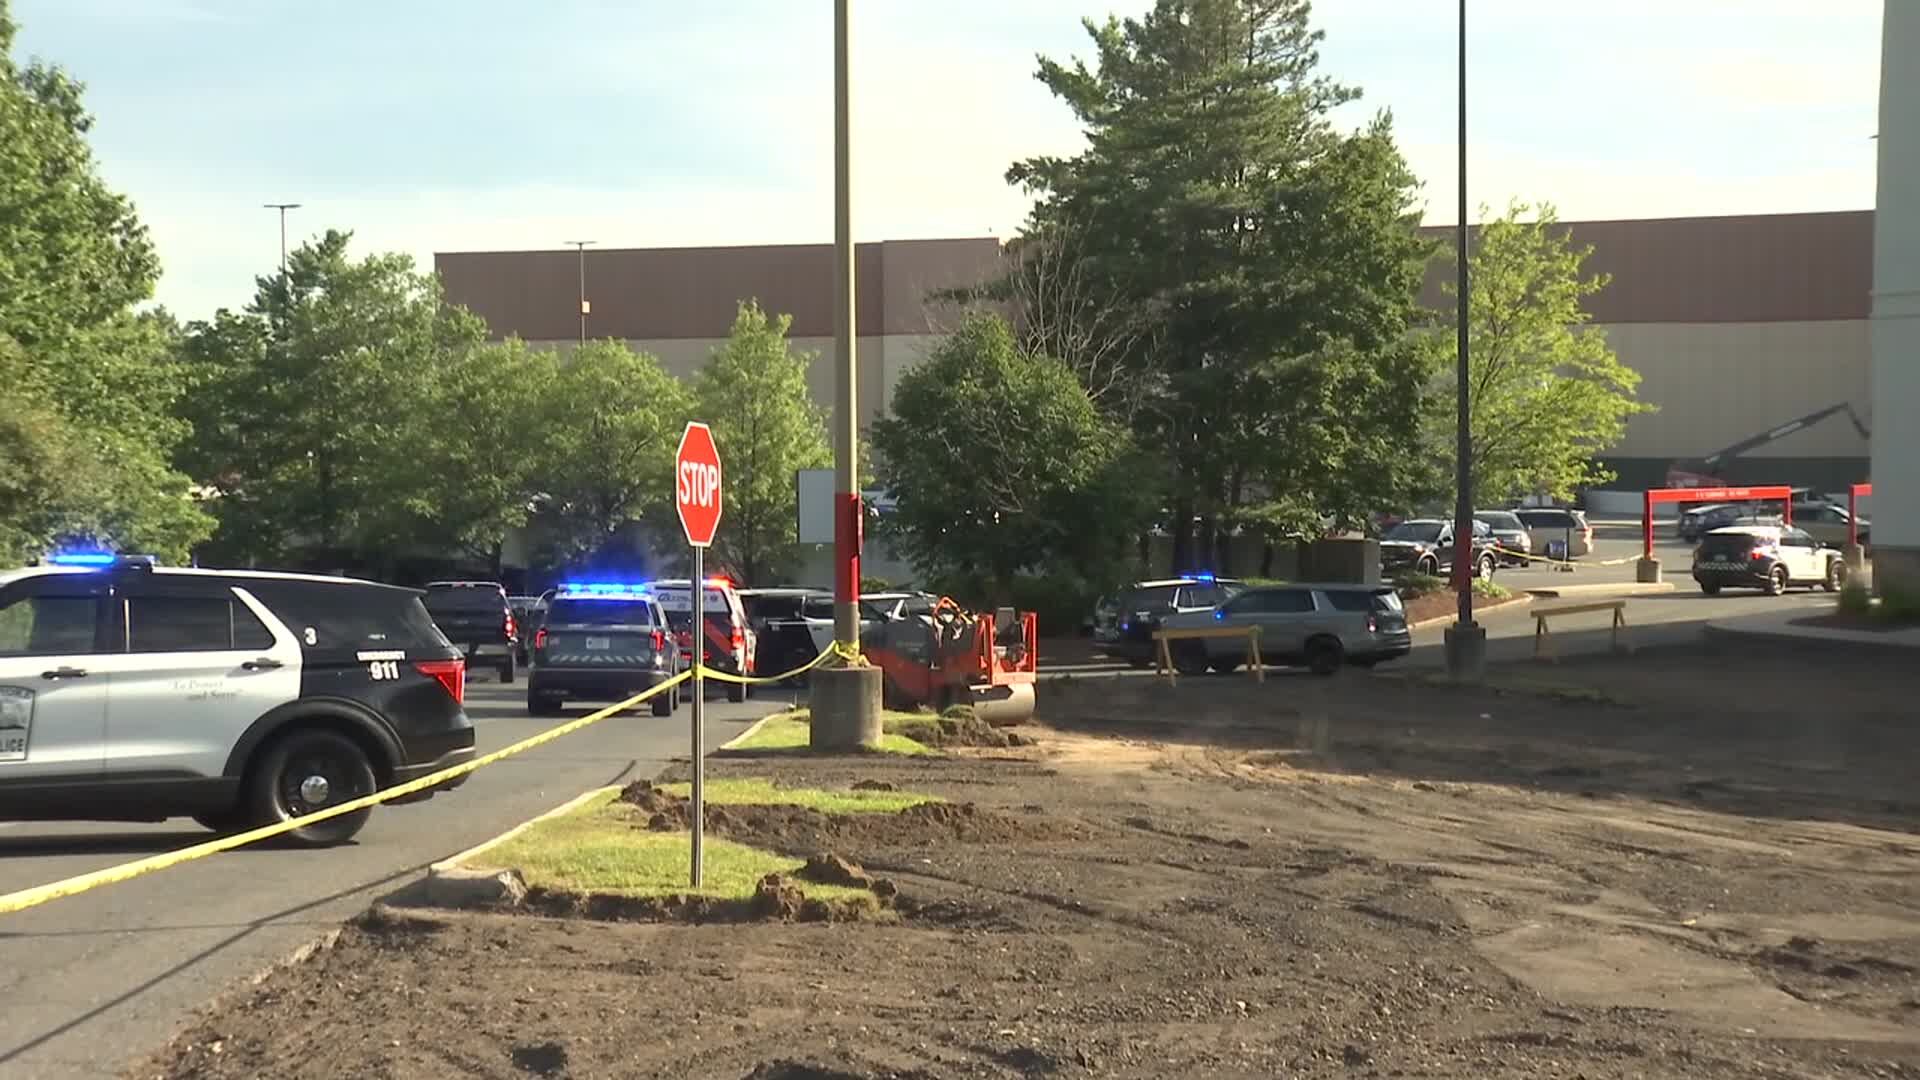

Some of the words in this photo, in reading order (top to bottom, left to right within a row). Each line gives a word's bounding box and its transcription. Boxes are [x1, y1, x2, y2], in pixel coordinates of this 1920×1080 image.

[680, 460, 718, 508] STOP
[305, 627, 317, 645] 3
[370, 661, 398, 680] 911
